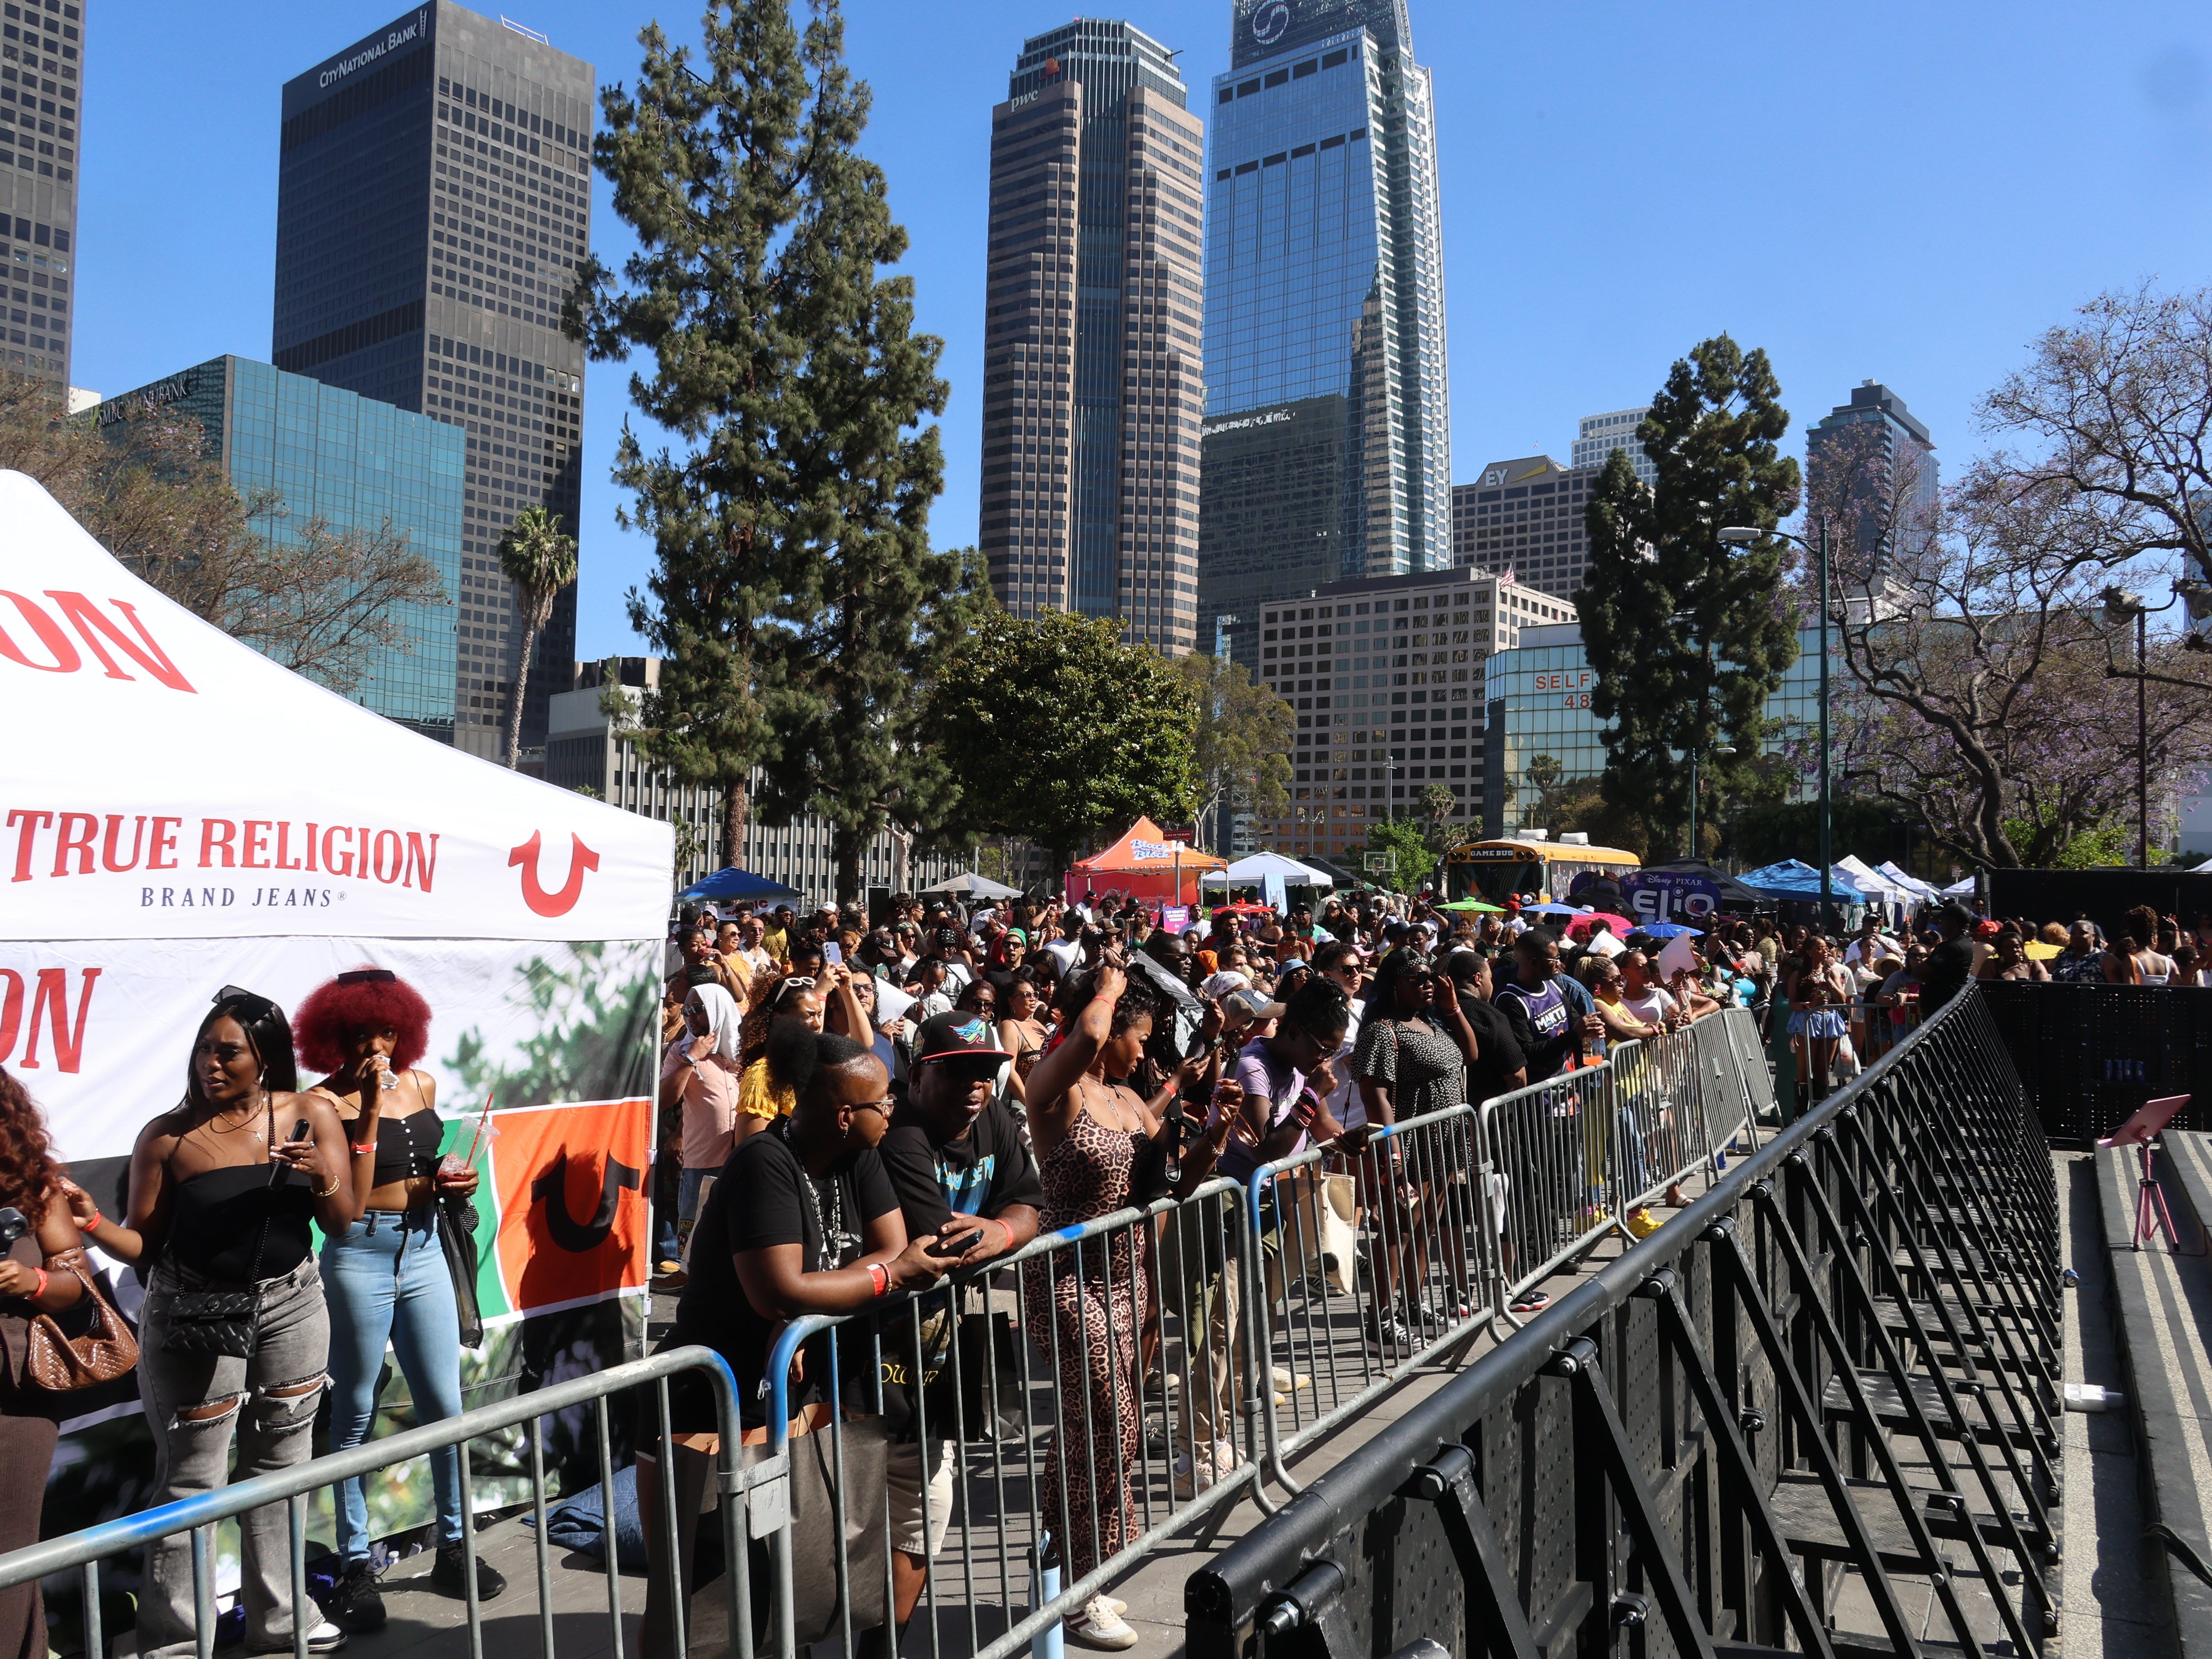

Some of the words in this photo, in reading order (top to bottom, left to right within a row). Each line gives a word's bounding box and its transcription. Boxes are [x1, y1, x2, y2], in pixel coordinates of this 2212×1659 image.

[387, 23, 417, 51] BANK
[1011, 89, 1039, 112] pwc
[1485, 468, 1509, 487] EY
[1535, 673, 1590, 690] SELF
[1564, 694, 1590, 709] 48
[6, 809, 182, 883] TRUE
[197, 818, 440, 893] RELIGION
[1130, 839, 1170, 851] Black
[1132, 850, 1171, 861] Block
[1675, 878, 1702, 886] PIXAR
[141, 888, 236, 907] BRAND
